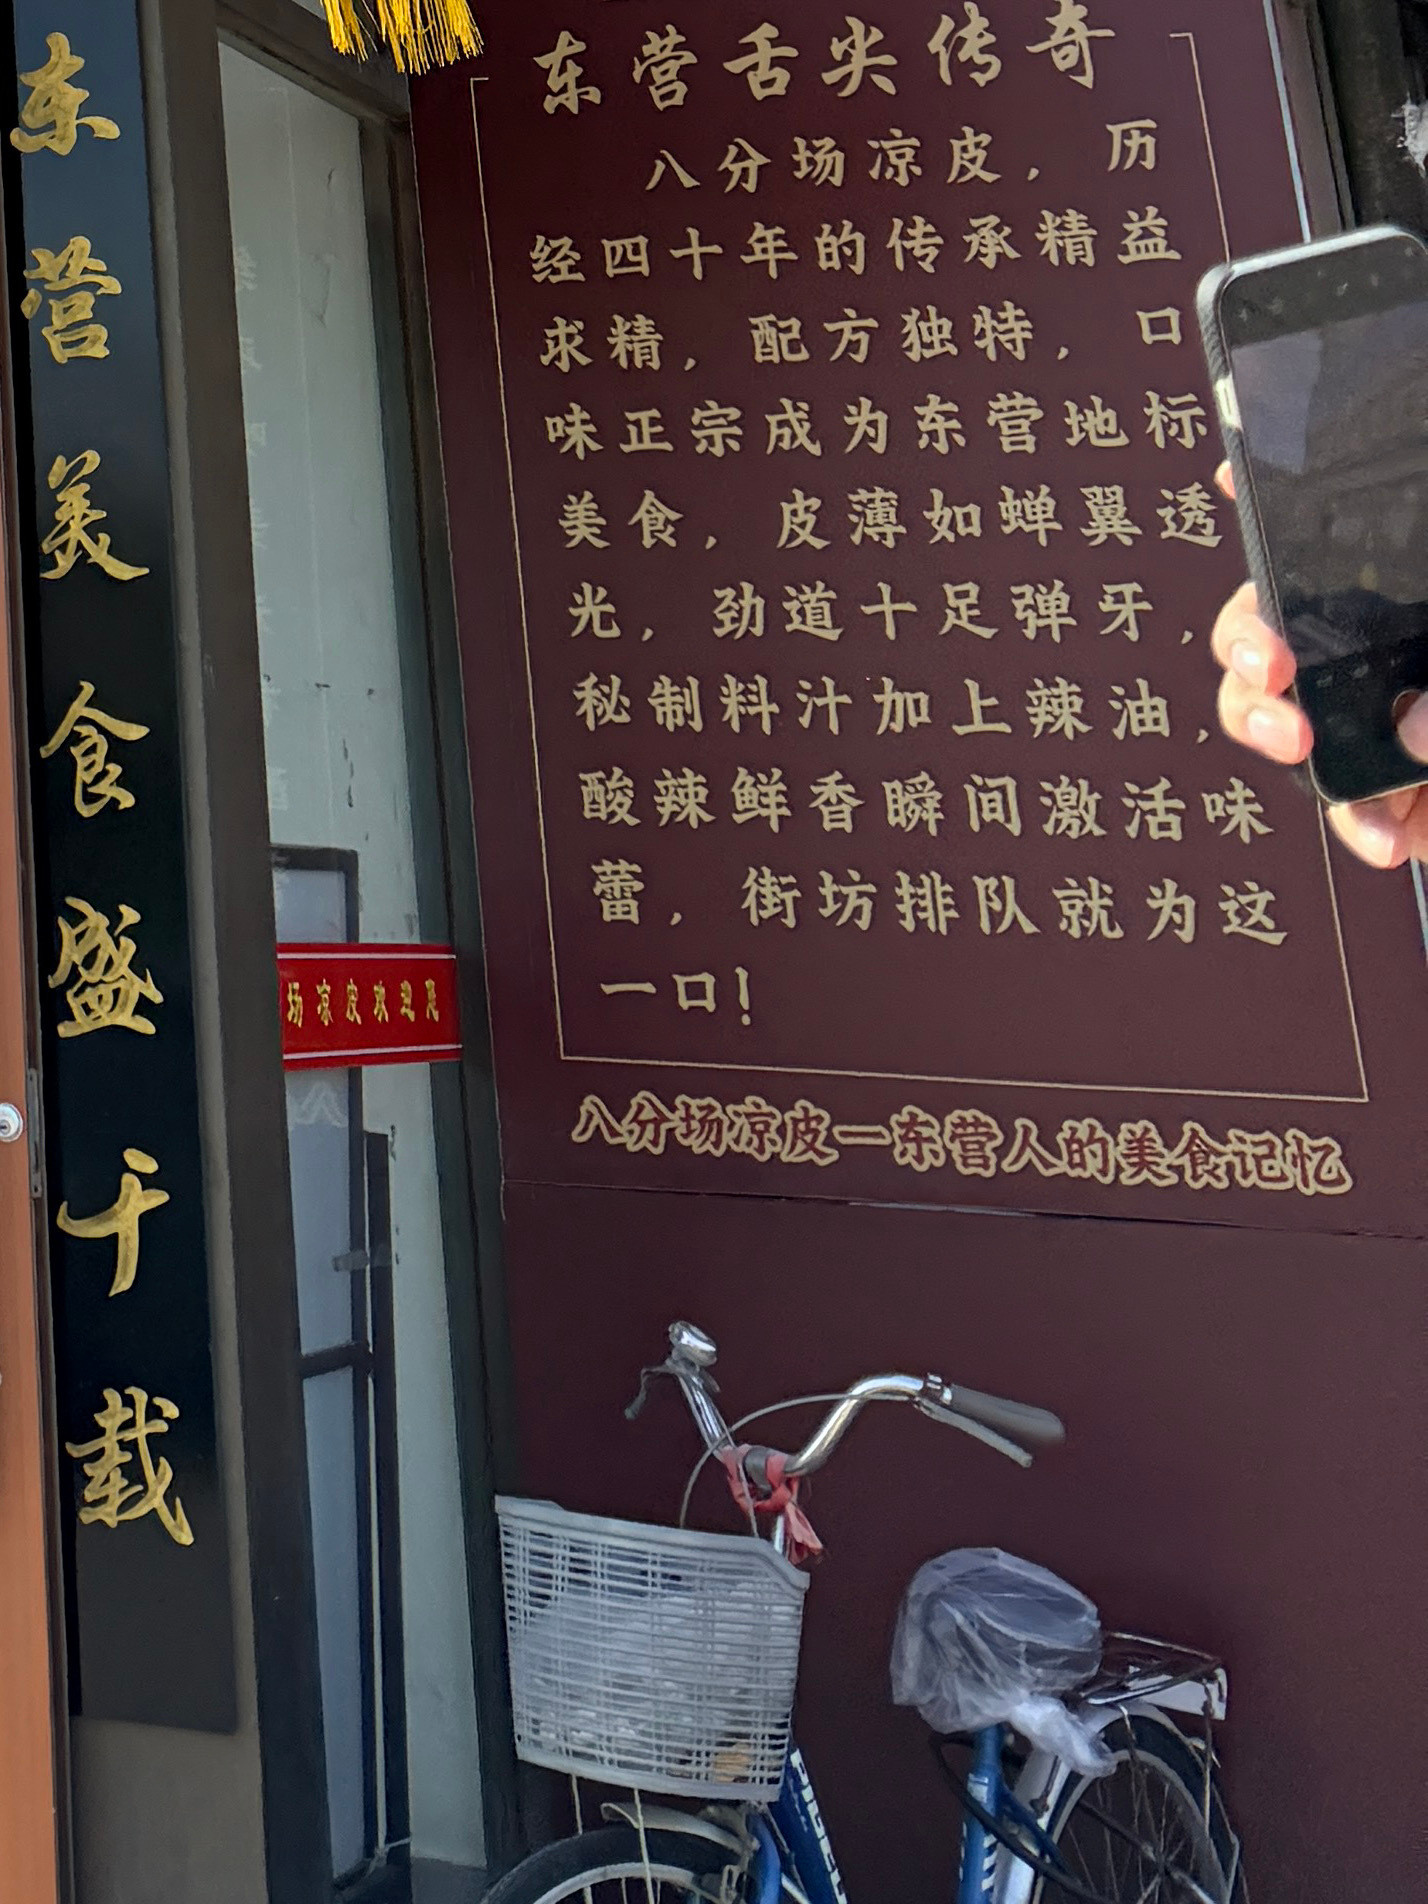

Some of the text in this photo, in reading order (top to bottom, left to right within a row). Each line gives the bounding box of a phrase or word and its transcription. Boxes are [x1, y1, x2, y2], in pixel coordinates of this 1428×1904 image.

[530, 205, 1183, 285] 经四十年的传承精益
[545, 390, 1209, 462] 味正宗成为东营地标
[557, 485, 1224, 551] 美食，皮薄如蝉翼透
[573, 671, 1213, 747] 秘制料汁加上辣油，
[8, 31, 196, 1550] 东营美食盛千载
[578, 766, 1275, 845] 酸辣鲜香瞬间激活味
[590, 859, 1289, 947] 蕾，街坊排队就为这
[599, 966, 753, 1027] 一口！
